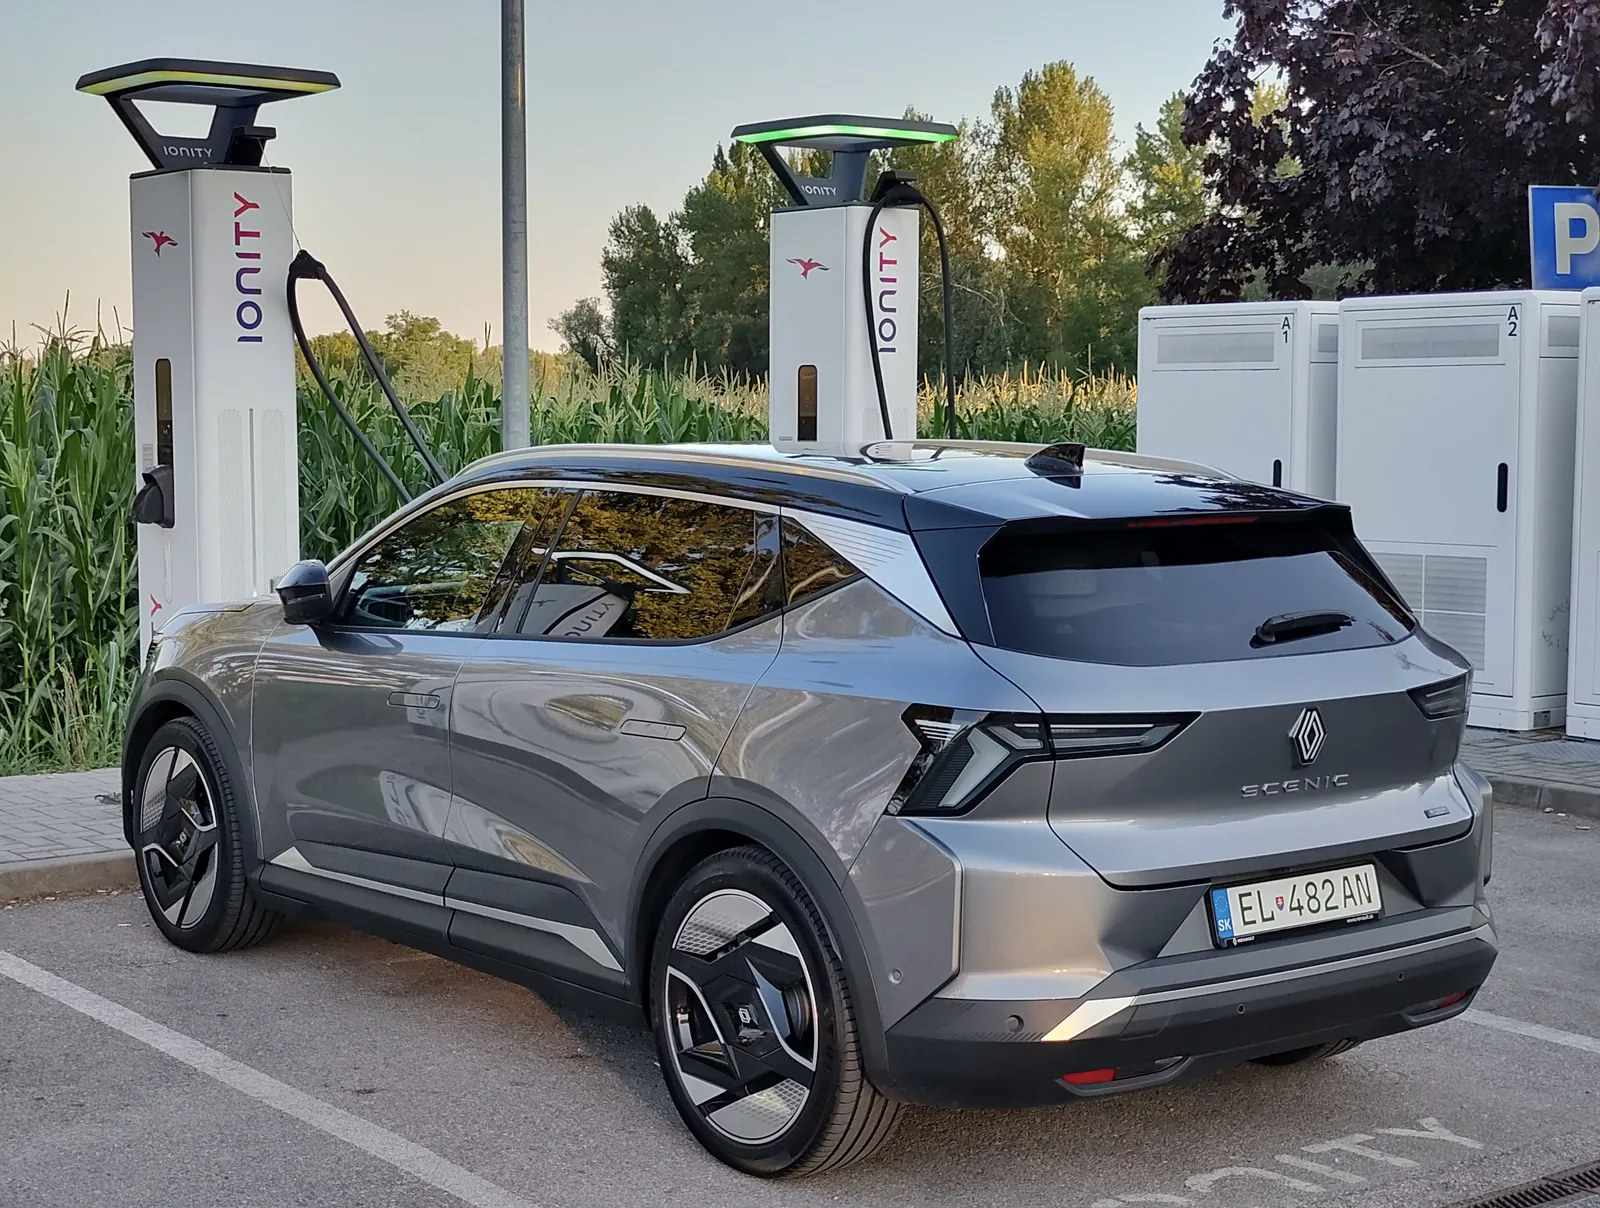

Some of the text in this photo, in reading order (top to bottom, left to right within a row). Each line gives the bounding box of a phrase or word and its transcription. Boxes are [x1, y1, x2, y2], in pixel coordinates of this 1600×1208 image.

[163, 145, 213, 158] IONITY
[801, 185, 837, 196] IONITY
[1553, 202, 1600, 275] P
[233, 191, 264, 343] IONITY
[877, 226, 898, 353] IONITY
[1507, 306, 1519, 321] A
[1281, 316, 1291, 330] A
[1507, 321, 1518, 337] 2
[1282, 330, 1288, 344] 1
[1240, 773, 1350, 799] SCENIC
[1237, 890, 1275, 927] EL
[1217, 918, 1232, 932] SK
